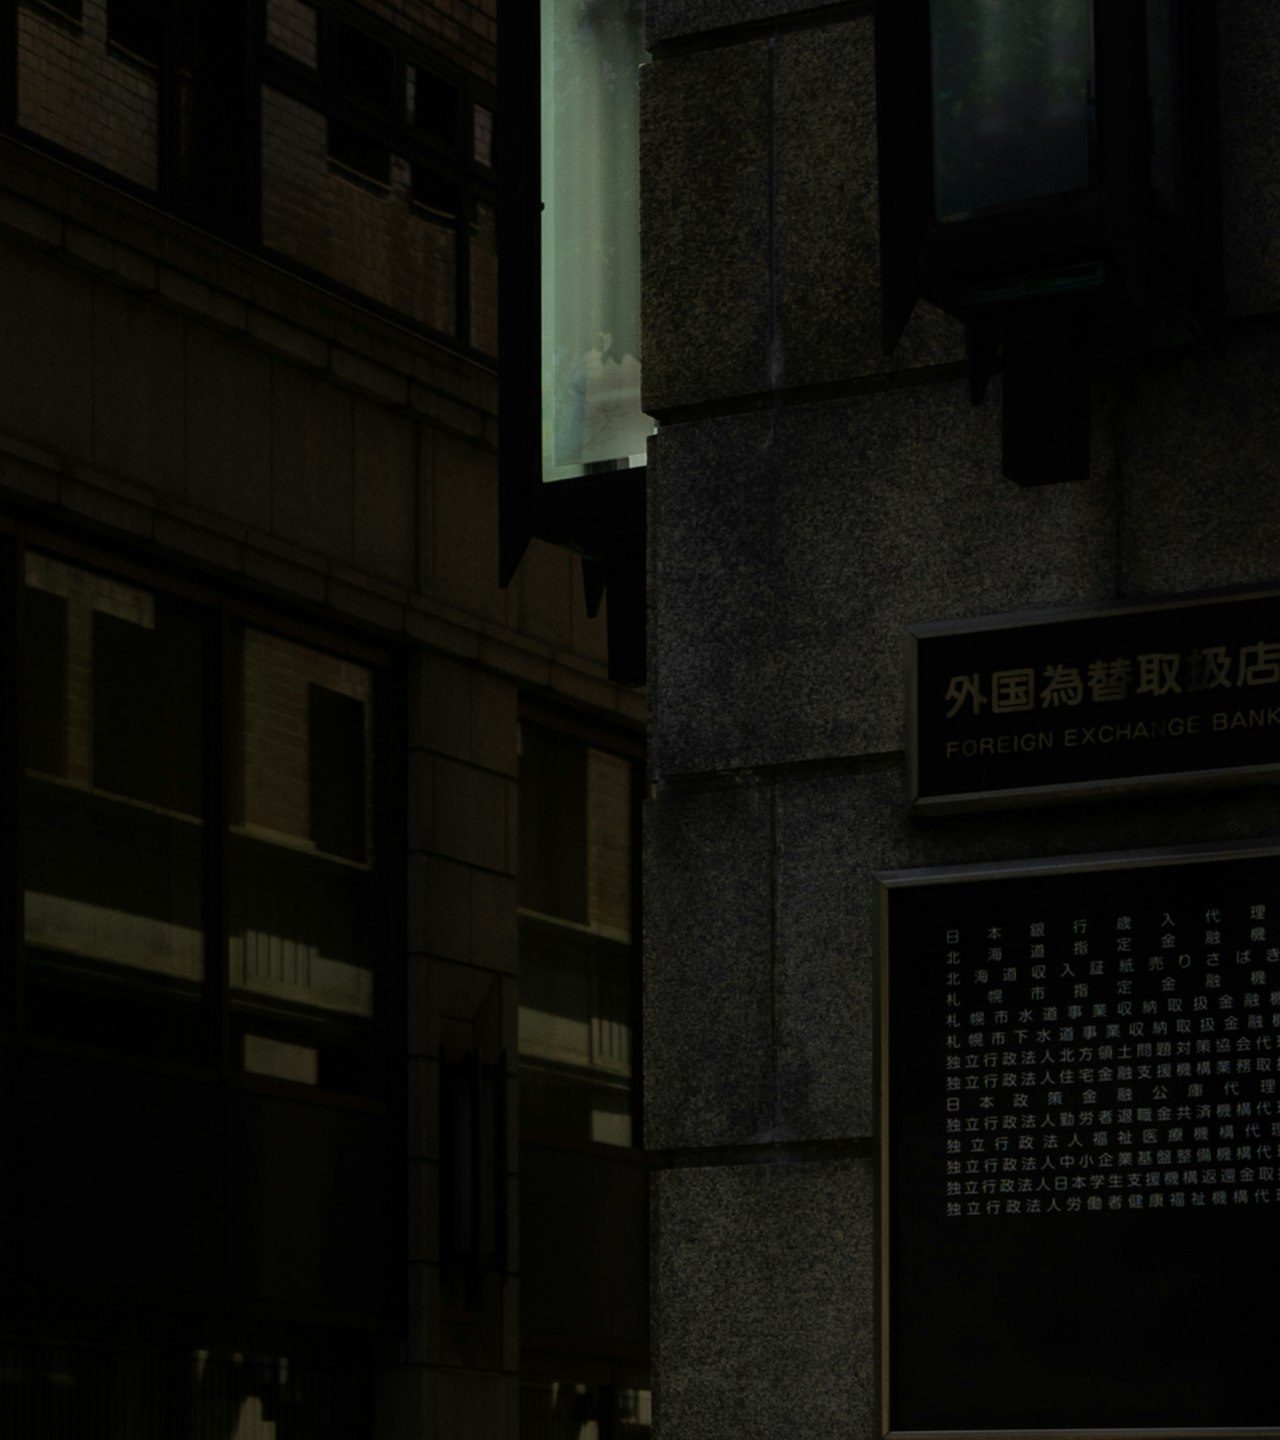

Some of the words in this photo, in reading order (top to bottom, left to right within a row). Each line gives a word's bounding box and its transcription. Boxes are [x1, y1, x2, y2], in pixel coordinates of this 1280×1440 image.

[945, 641, 1280, 719] 外国為替取扱店
[946, 731, 1053, 760] FOREIGN
[1064, 715, 1201, 747] EXCHANGE
[1213, 706, 1280, 732] BANK
[946, 1035, 1280, 1070] 独立行政法人北方領土問題対策協会代
[946, 1056, 1280, 1091] 独立行政法人住宅金融支援機構業務取
[946, 1099, 1280, 1133] 独立行政法人勤労者退職金共済機構代
[946, 1144, 1280, 1175] 独立行政法人中小企業基盤整備機構代
[946, 1166, 1280, 1196] 独立行政法人日本学生支援機構返還金取
[946, 1187, 1280, 1217] 独立行政法人労働者健康福祉機構代
